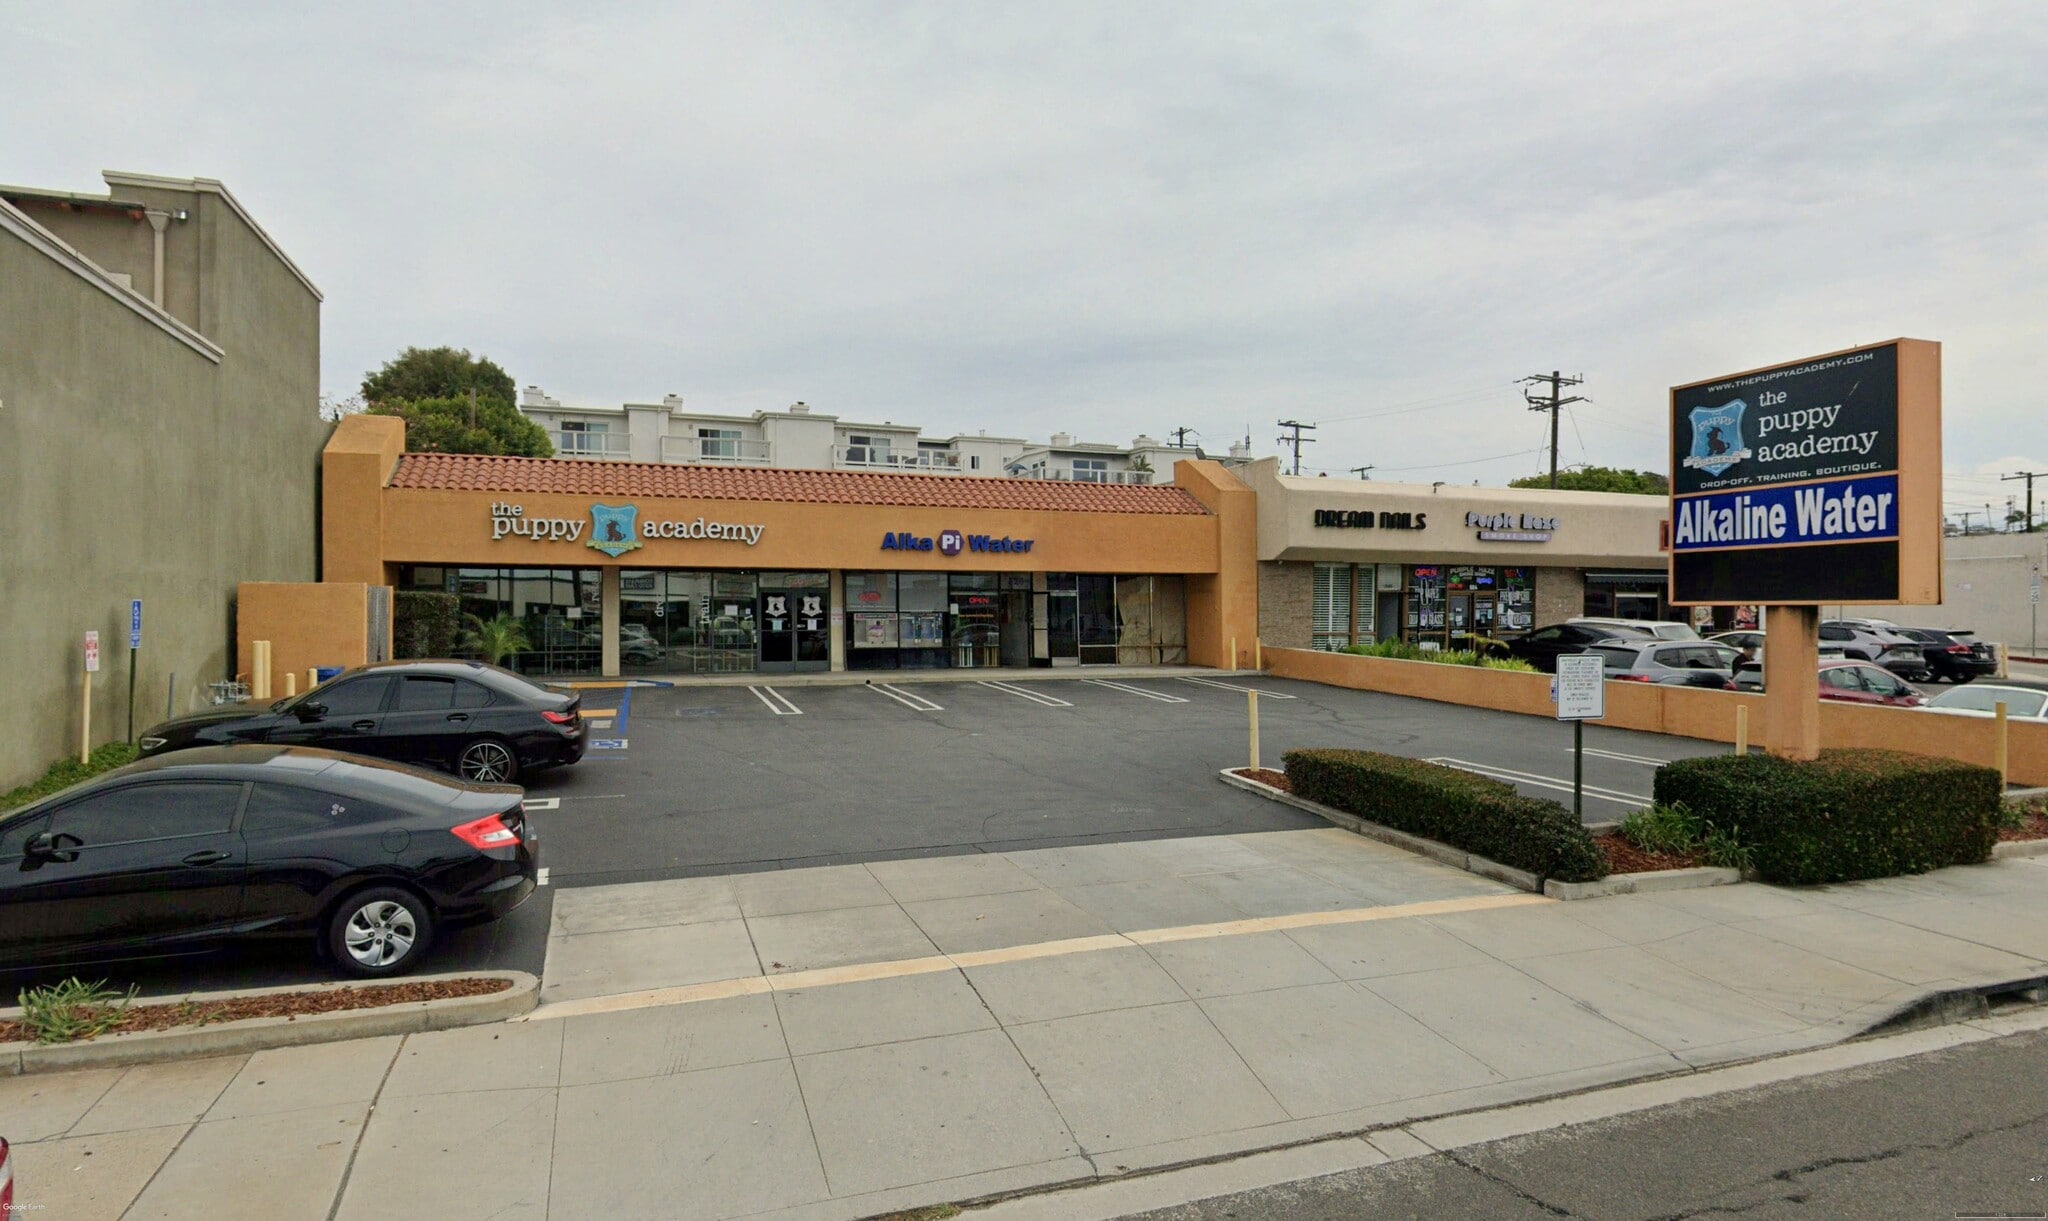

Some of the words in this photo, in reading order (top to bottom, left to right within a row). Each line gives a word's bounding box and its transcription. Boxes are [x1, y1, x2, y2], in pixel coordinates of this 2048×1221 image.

[1707, 353, 1874, 393] WWW.THEPUPPYACADEMY.COM
[1759, 390, 1787, 407] the
[1698, 416, 1735, 431] puppy
[1758, 404, 1842, 437] puppy
[1758, 431, 1879, 463] academy
[1700, 478, 1753, 489] DROP-OFF.
[1757, 470, 1812, 482] TRAINING.
[1816, 462, 1882, 476] BOUTIQUE.
[491, 502, 523, 517] the
[1314, 509, 1375, 528] DREAM
[1380, 511, 1427, 529] NAILS
[1675, 495, 1787, 544] Alkaline
[1794, 485, 1893, 537] Water
[491, 516, 586, 541] puppy
[643, 518, 765, 545] academy
[1466, 511, 1517, 531] Purple
[881, 532, 934, 550] Alka
[942, 535, 960, 549] Pi
[968, 534, 1035, 553] Water
[1415, 568, 1438, 577] OPEN
[969, 596, 990, 604] OPEN
